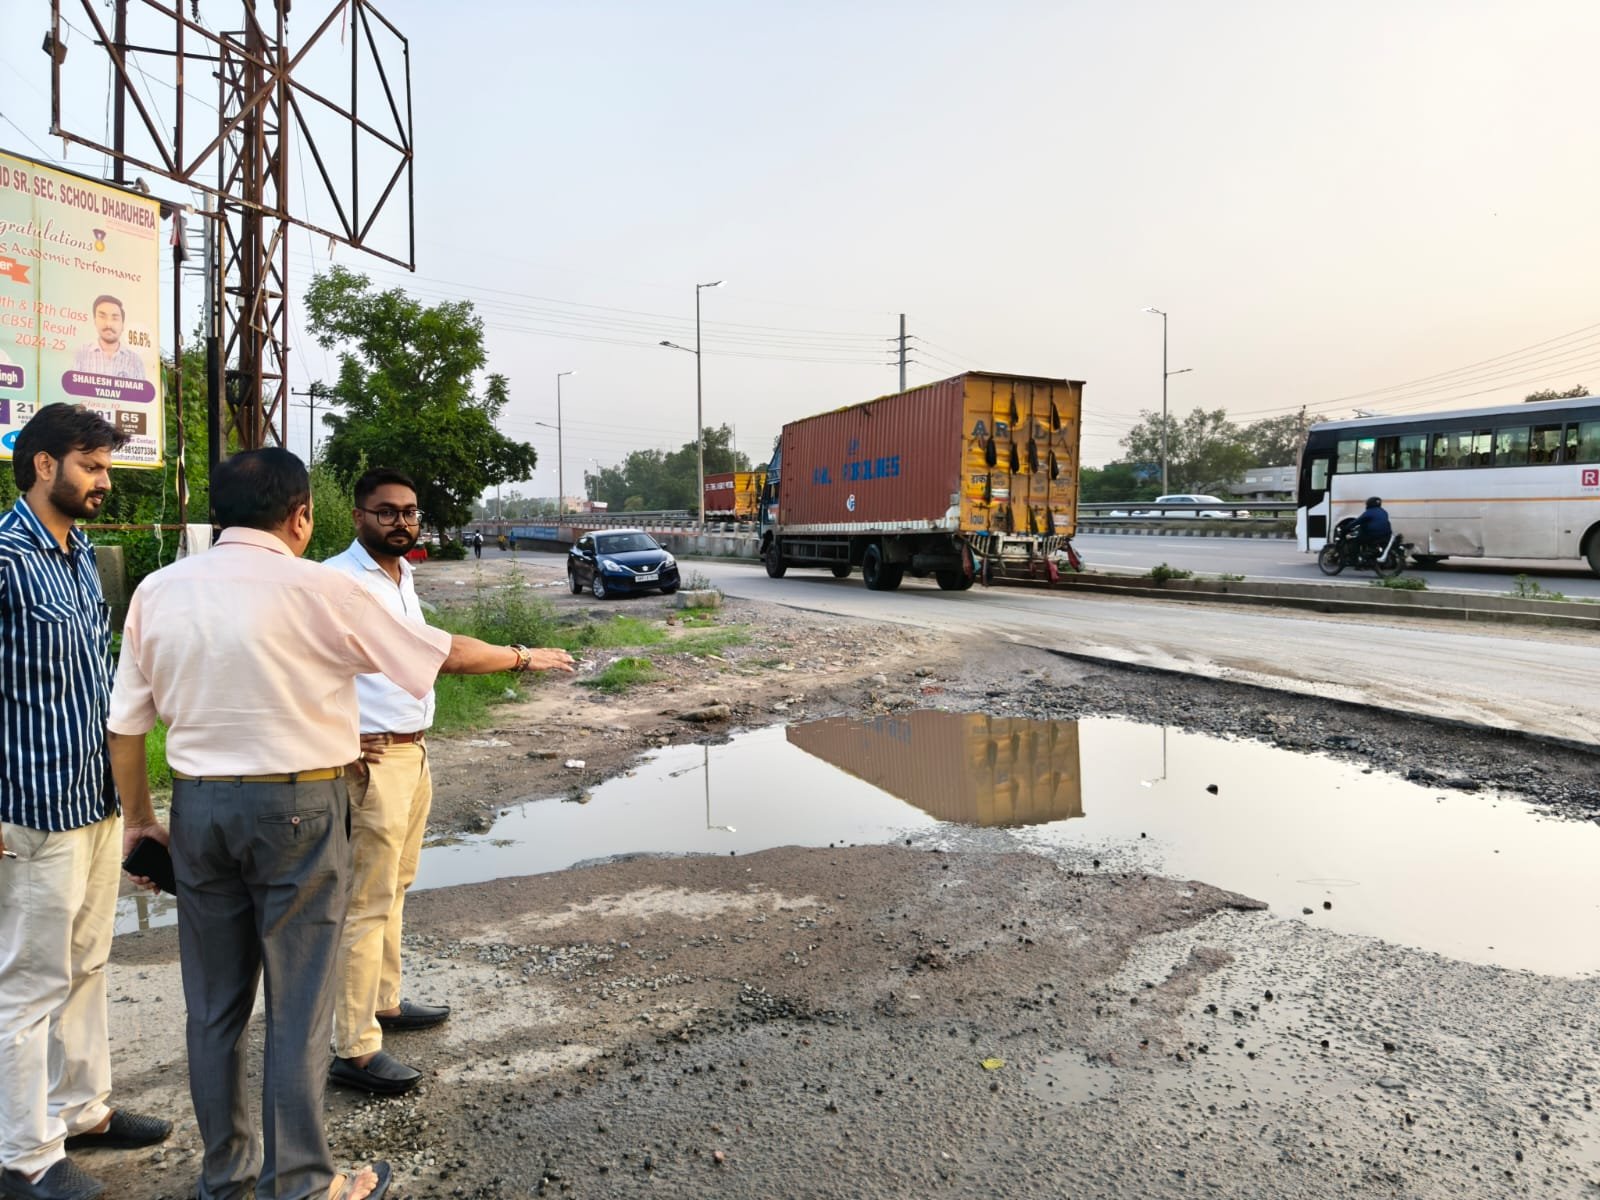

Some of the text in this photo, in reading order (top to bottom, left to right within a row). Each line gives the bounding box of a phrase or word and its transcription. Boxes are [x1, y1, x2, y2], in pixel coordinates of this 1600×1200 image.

[13, 169, 30, 194] SR.
[60, 183, 100, 213] SCHOOL
[102, 196, 156, 230] DHARUHERA
[12, 242, 70, 266] Academic
[73, 257, 142, 282] Performance
[0, 295, 15, 309] th
[33, 301, 56, 317] 12th
[59, 306, 89, 322] Class
[1, 313, 77, 337] CBSE Result
[15, 332, 66, 351] 2024-25
[128, 329, 151, 348] 96.6%
[72, 373, 144, 391] SHAILESH KUMAR
[95, 387, 121, 399] YADAV
[16, 402, 34, 414] 21
[121, 412, 139, 423] 65
